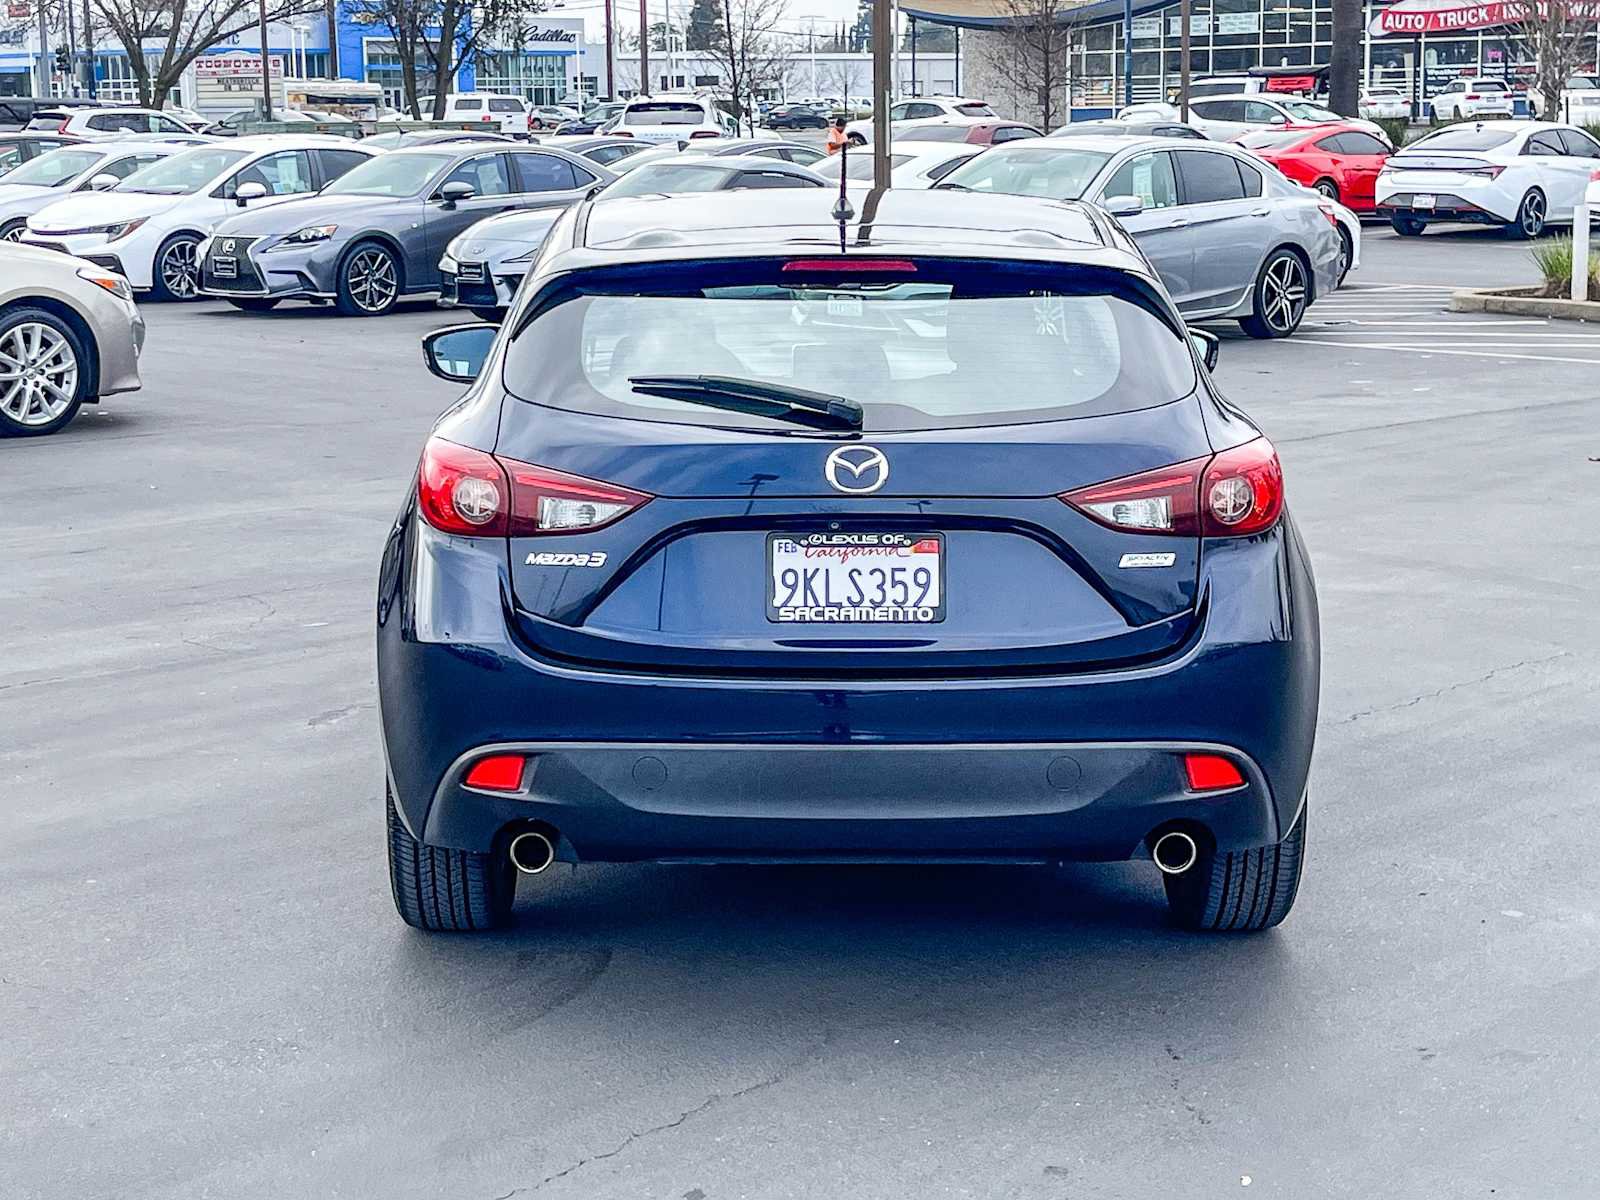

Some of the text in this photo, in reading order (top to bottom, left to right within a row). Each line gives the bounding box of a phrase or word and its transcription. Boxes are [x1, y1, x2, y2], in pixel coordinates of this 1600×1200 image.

[1384, 14, 1425, 30] AUTO
[1437, 8, 1489, 28] TRUCK
[521, 25, 576, 43] Cadillac
[195, 59, 280, 69] TOGNOTT'S
[777, 541, 798, 553] FEB
[821, 534, 905, 545] LEXUS OF
[804, 546, 911, 565] California
[780, 567, 932, 607] 9KLS359
[778, 607, 935, 622] SACRAMENTO
